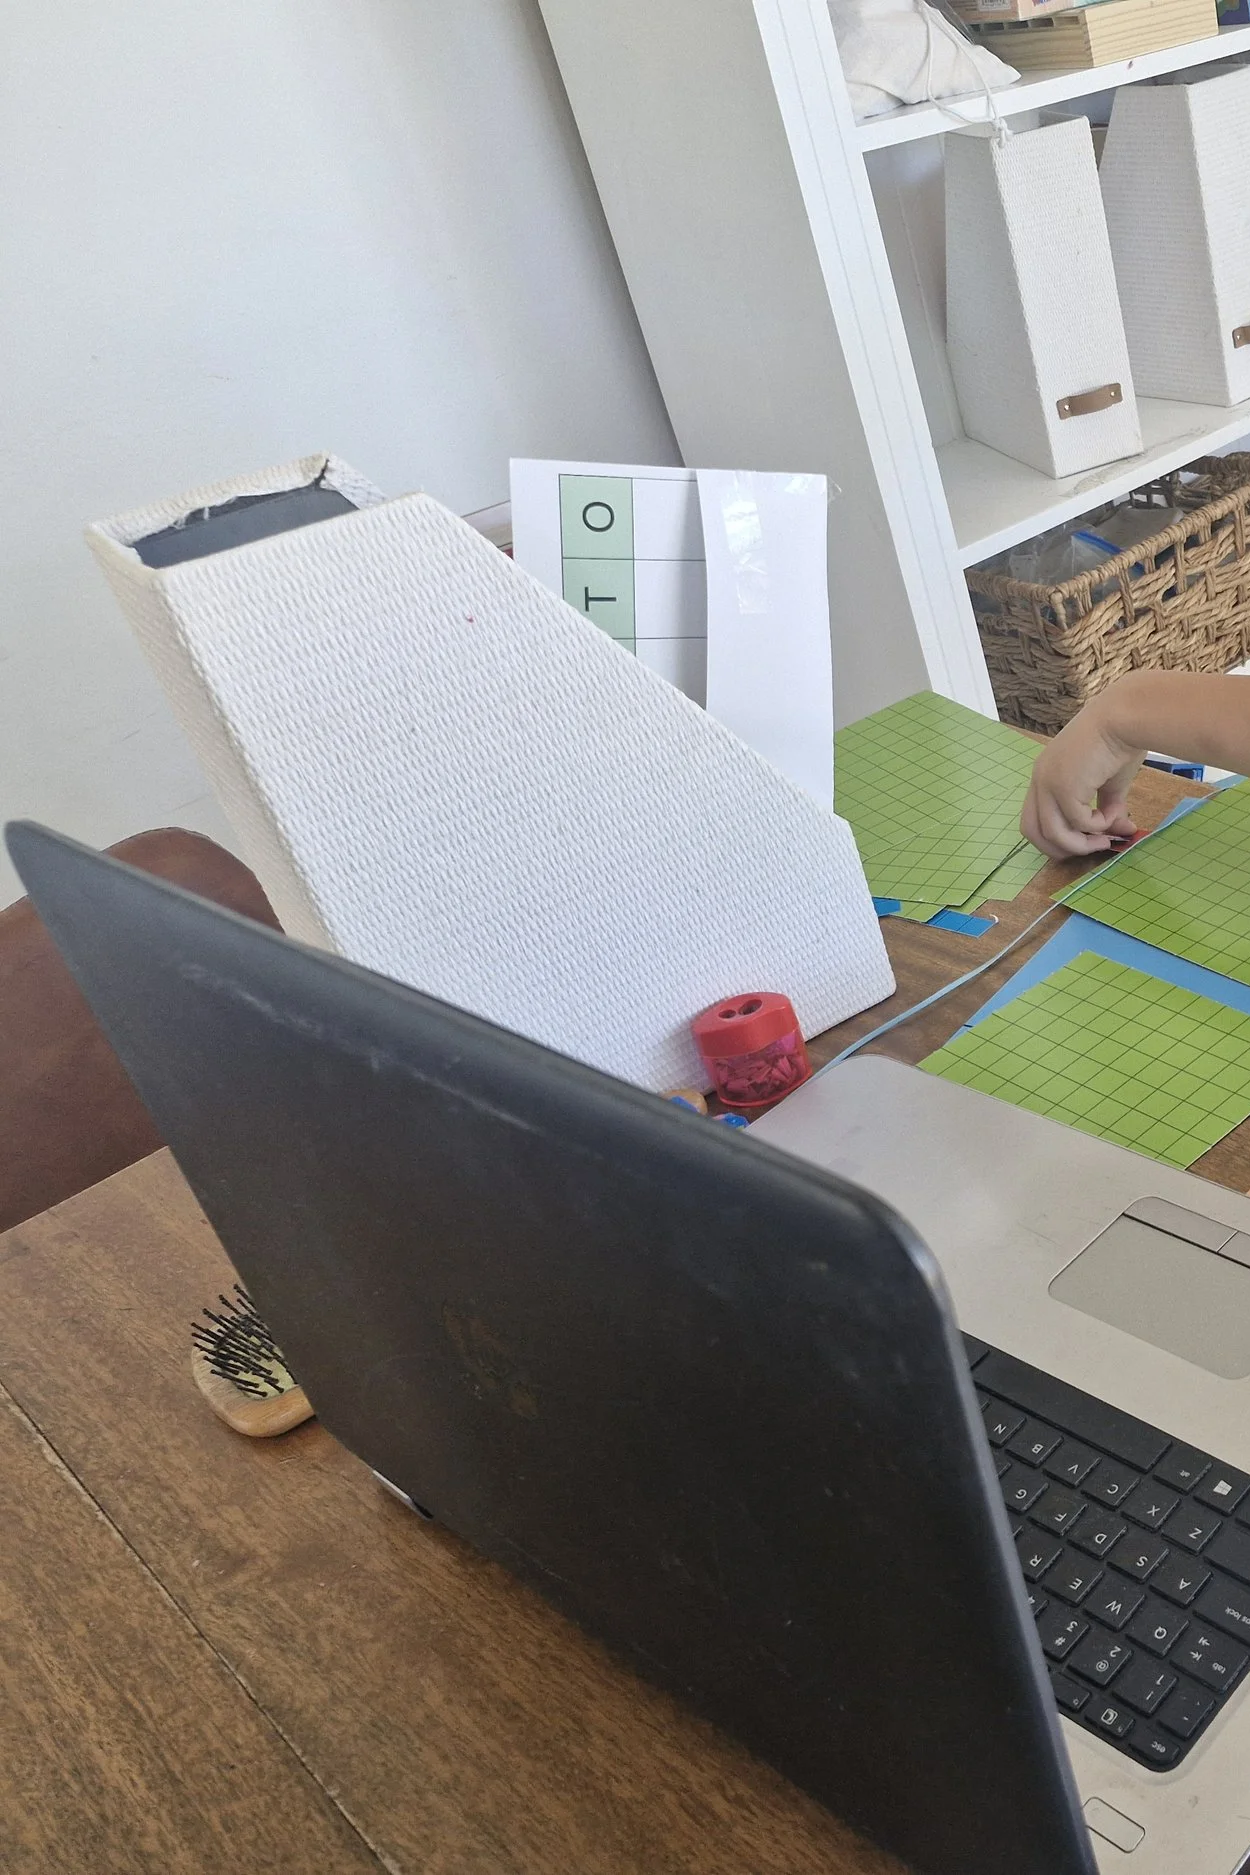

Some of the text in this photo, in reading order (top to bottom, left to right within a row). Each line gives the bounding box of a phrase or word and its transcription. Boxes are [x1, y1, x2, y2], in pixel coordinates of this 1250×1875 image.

[582, 501, 617, 612] T O
[993, 1423, 1007, 1435] N
[1031, 1443, 1044, 1454] B
[1067, 1464, 1079, 1474] V
[1015, 1489, 1027, 1499] G
[1106, 1484, 1119, 1495] C
[1146, 1505, 1161, 1517] X
[1054, 1513, 1067, 1522] F
[1094, 1533, 1108, 1545] D
[1188, 1527, 1203, 1539] Z
[1029, 1554, 1042, 1567] R
[1136, 1556, 1148, 1567] S
[1069, 1578, 1083, 1590] E
[1179, 1578, 1191, 1590] A
[1105, 1600, 1122, 1615] W
[1225, 1607, 1242, 1621] lock
[1066, 1620, 1078, 1632] 3
[1154, 1626, 1167, 1640] Q
[1109, 1645, 1121, 1658] 2
[1212, 1662, 1226, 1674] tab
[1156, 1674, 1164, 1685] 1
[1151, 1741, 1166, 1753] esc
